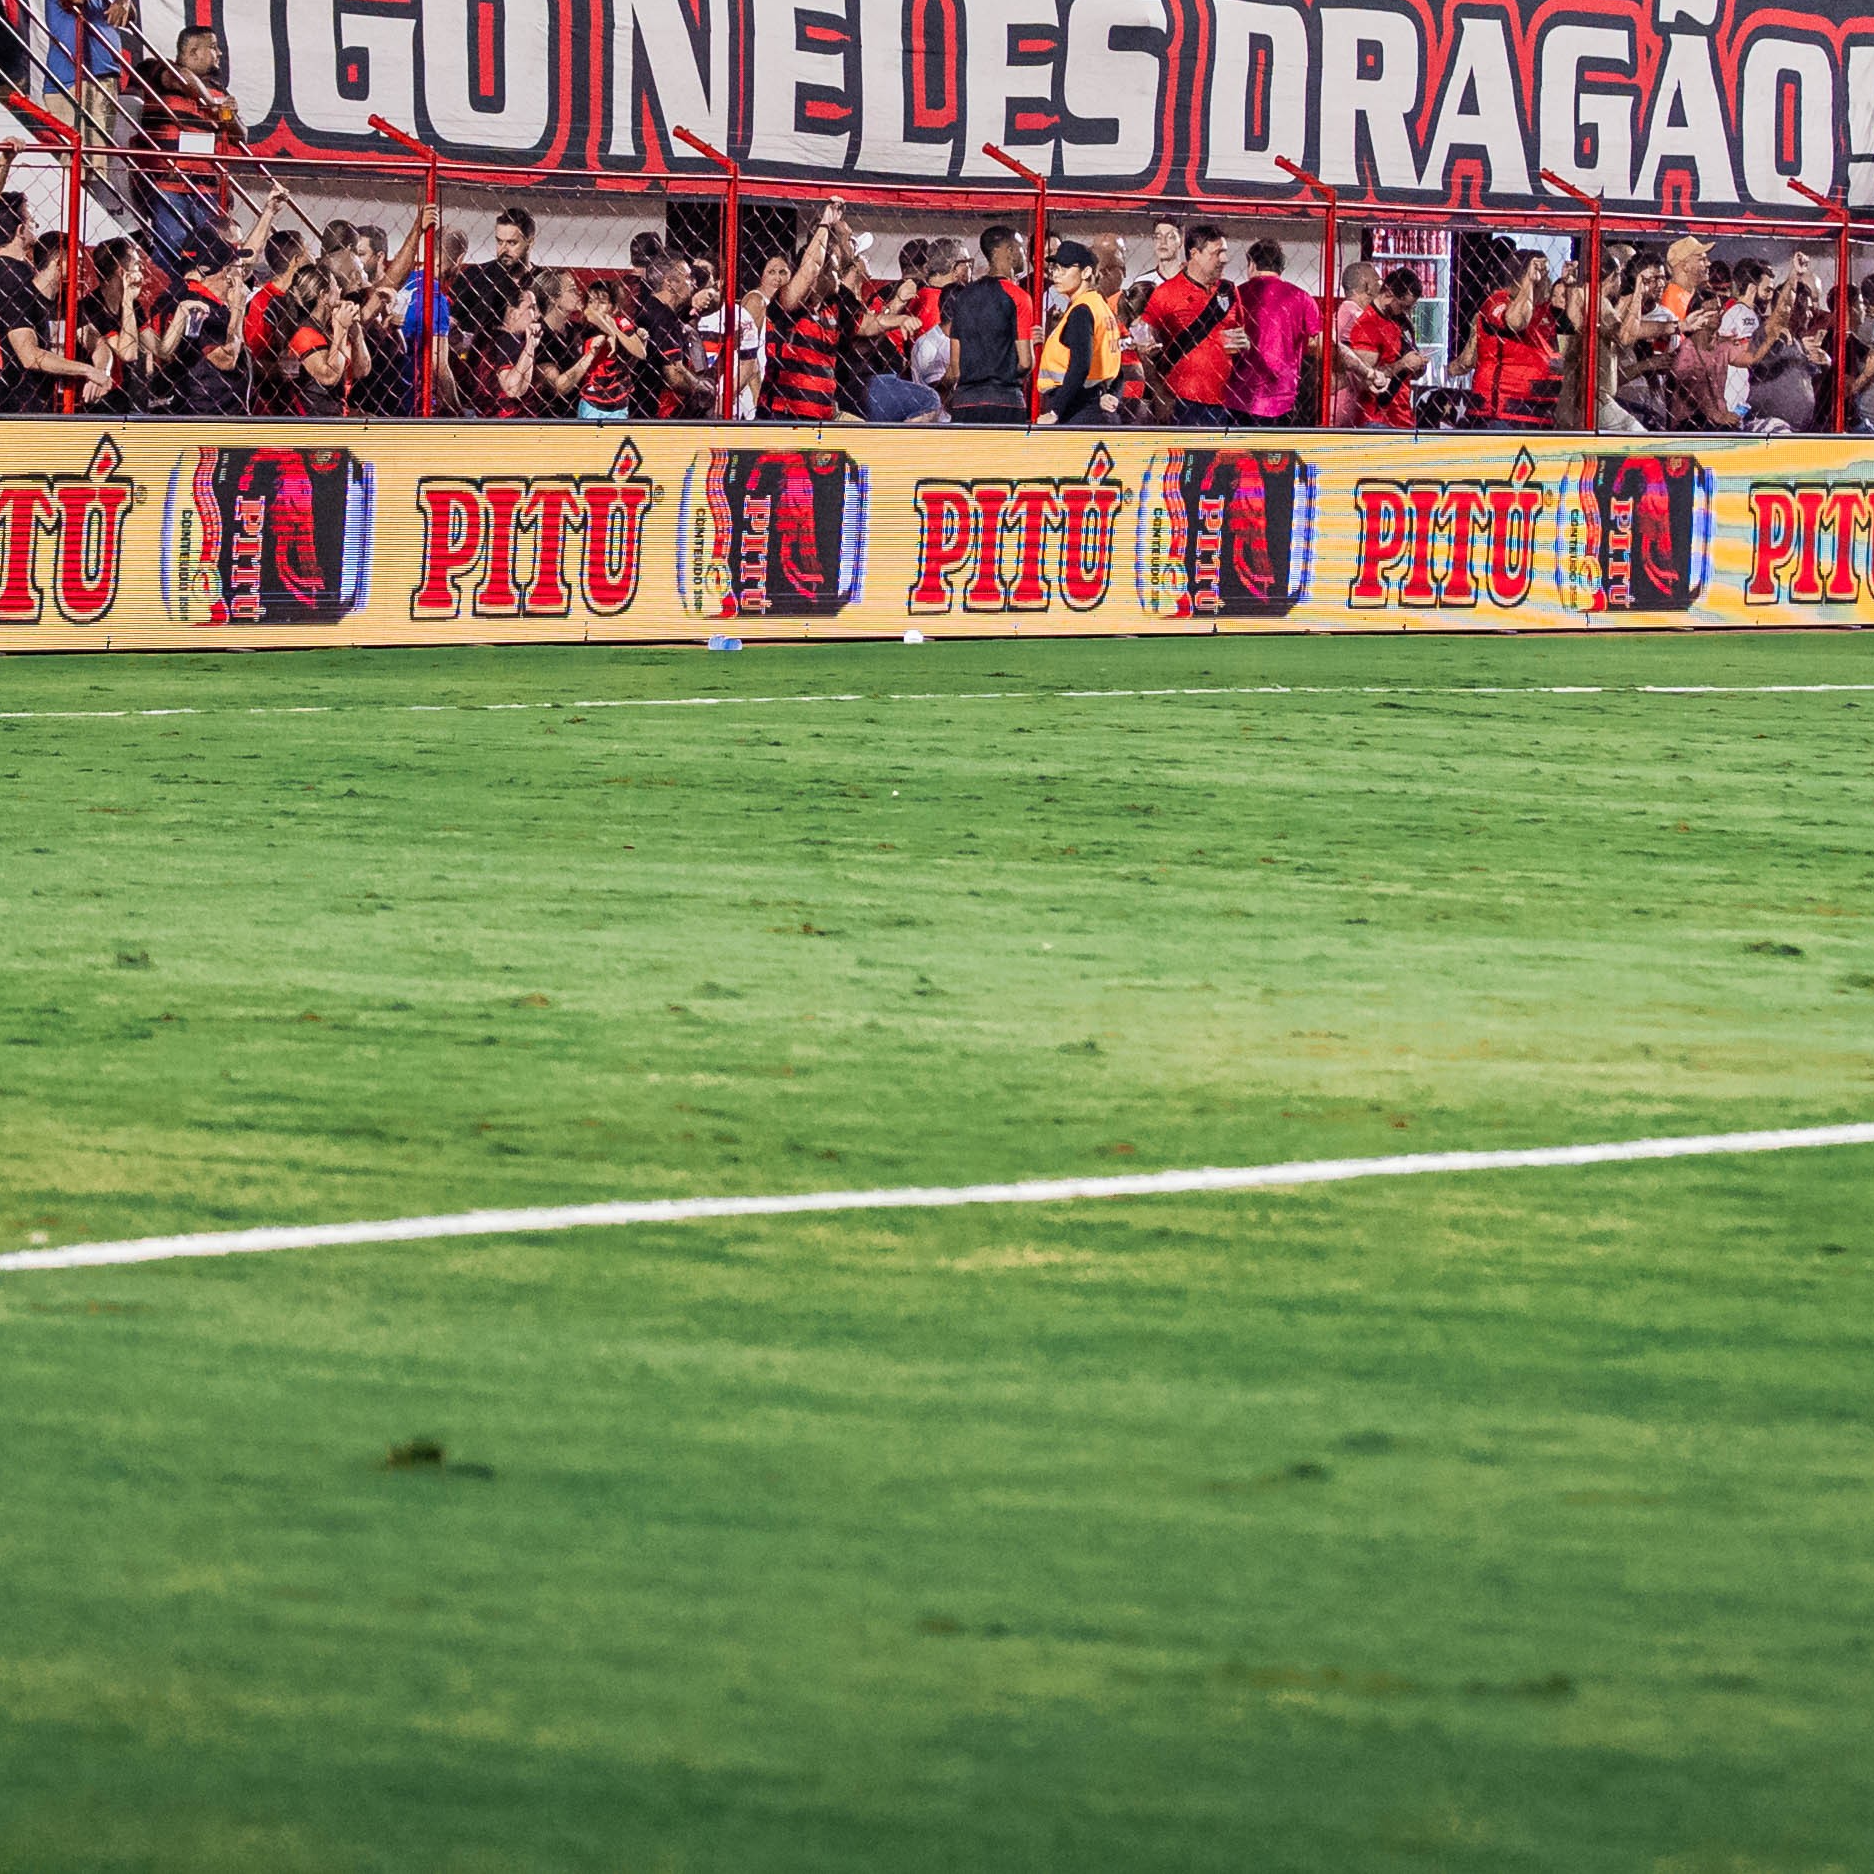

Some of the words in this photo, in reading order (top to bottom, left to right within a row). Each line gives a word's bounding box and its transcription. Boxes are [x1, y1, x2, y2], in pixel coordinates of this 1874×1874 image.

[410, 435, 655, 621] PITÚ
[907, 440, 1128, 616] PITÚ
[1348, 445, 1547, 610] PITÚ
